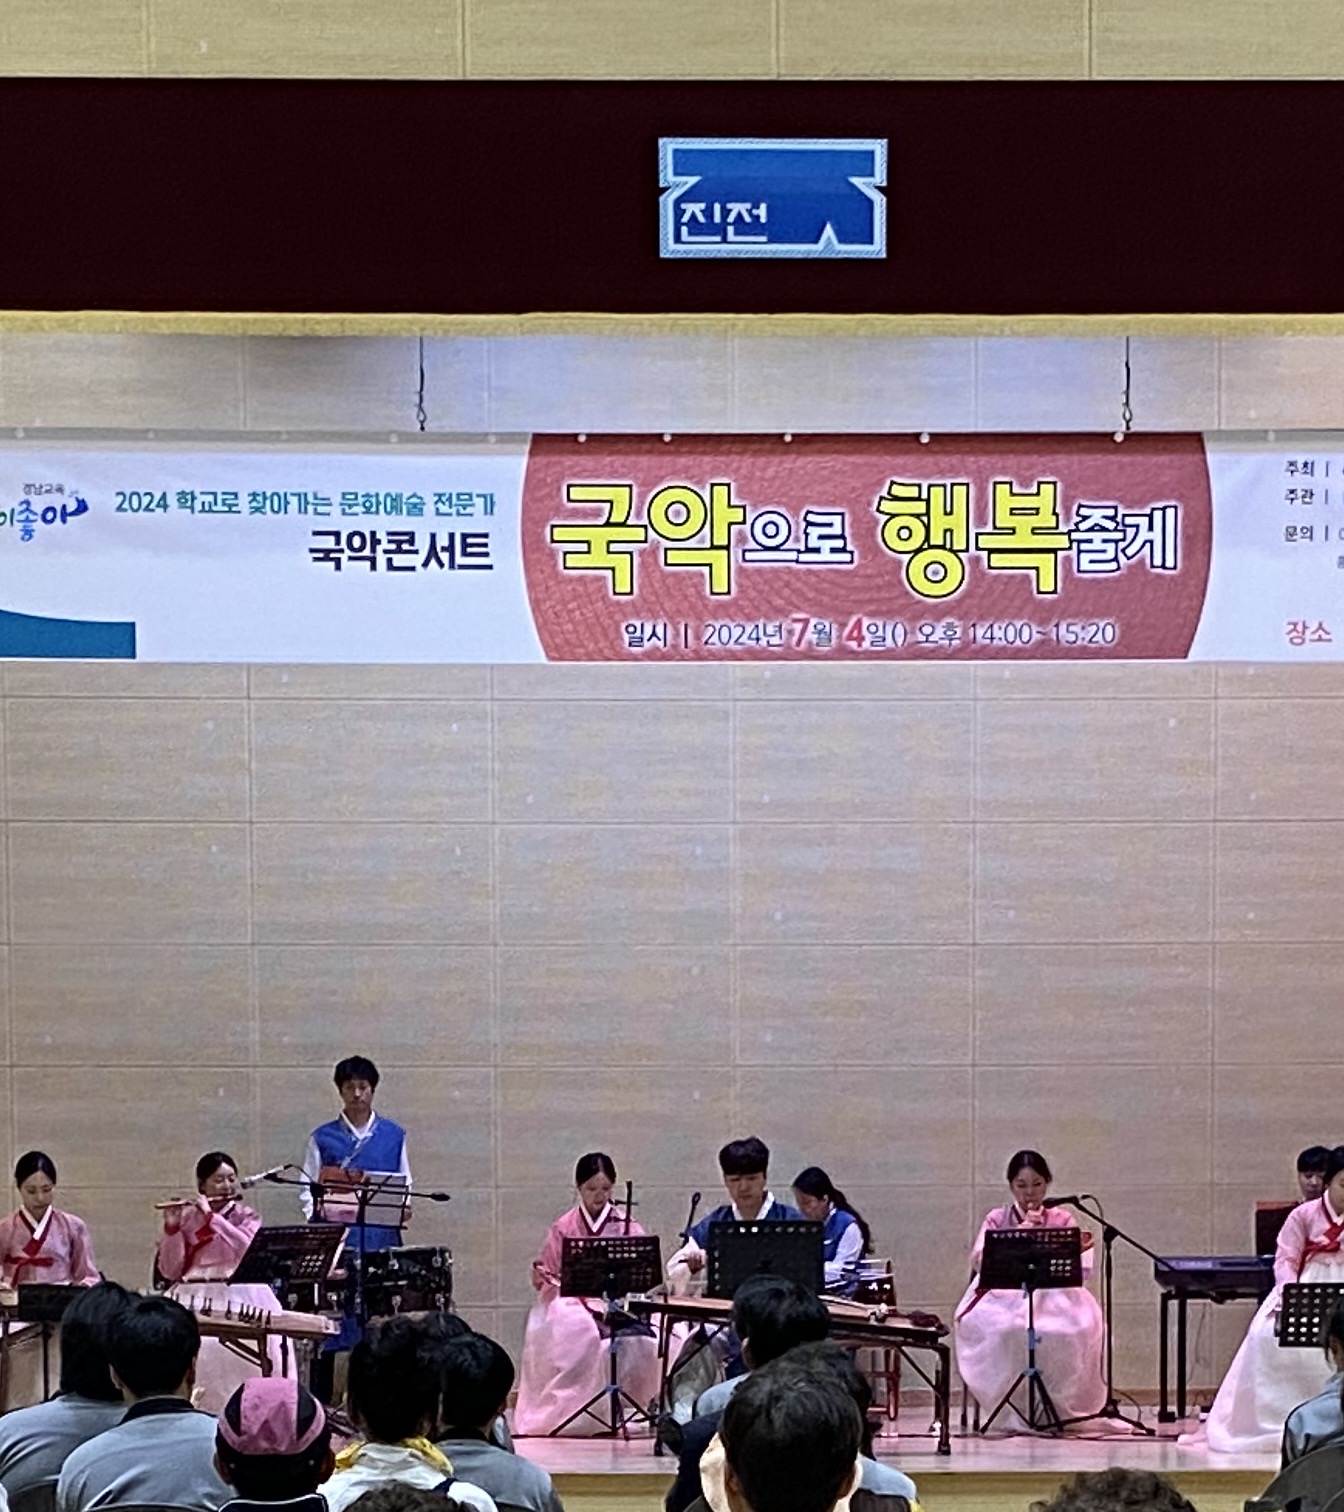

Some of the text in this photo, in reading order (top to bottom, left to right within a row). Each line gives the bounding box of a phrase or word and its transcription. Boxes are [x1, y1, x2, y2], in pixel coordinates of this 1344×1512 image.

[679, 202, 768, 242] 진전
[1284, 459, 1316, 478] 주최
[114, 490, 497, 516] 2024 학교로 찾아가는 문화예술 전문가
[1284, 487, 1316, 506] 주관
[550, 481, 855, 596] 국악으로
[1284, 525, 1315, 543] 문의
[308, 529, 494, 572] 국악콘서트
[624, 621, 668, 648] 일시
[704, 621, 784, 648] 2024년
[791, 616, 834, 648] 7월
[915, 620, 961, 648] 오후
[968, 621, 1117, 645] 14:00~15:20
[1285, 619, 1333, 647] 장소
